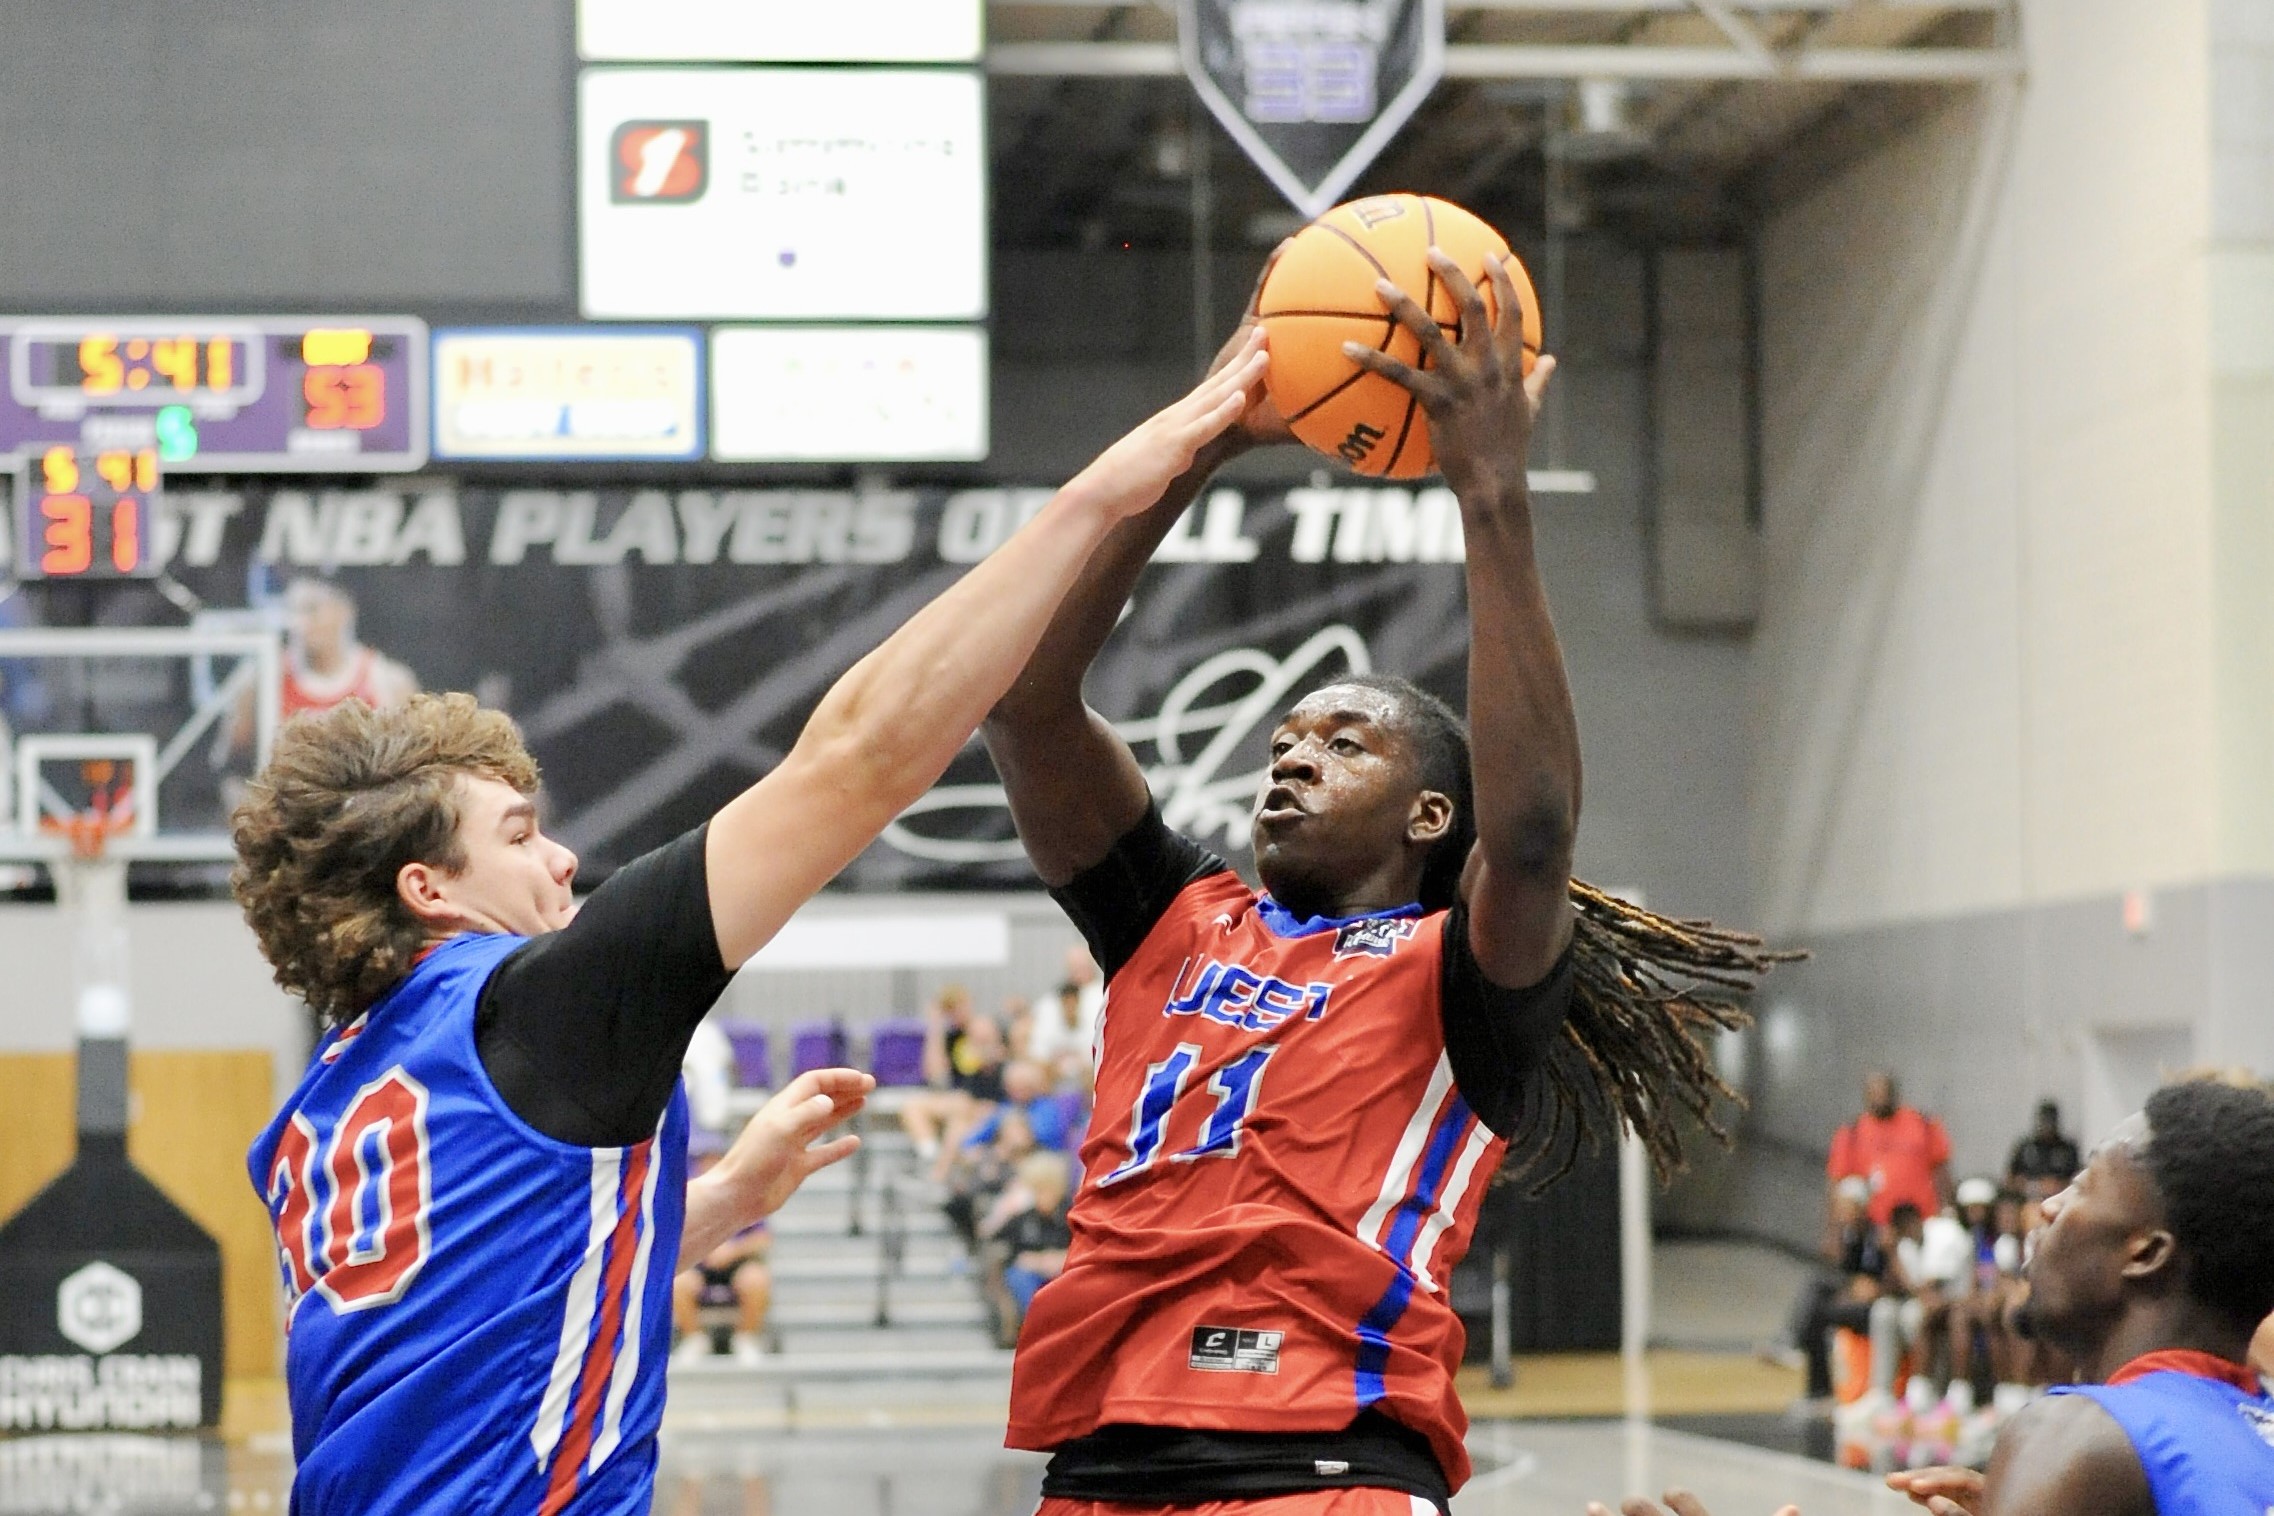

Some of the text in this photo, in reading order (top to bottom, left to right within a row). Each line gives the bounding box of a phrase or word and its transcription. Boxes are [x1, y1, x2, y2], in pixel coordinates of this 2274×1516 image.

[80, 333, 233, 396] 5:41
[40, 494, 138, 575] 31
[260, 490, 466, 566] NBA
[490, 489, 919, 565] PLAYERS
[1150, 488, 1261, 563] LL
[1096, 1042, 1281, 1187] 11
